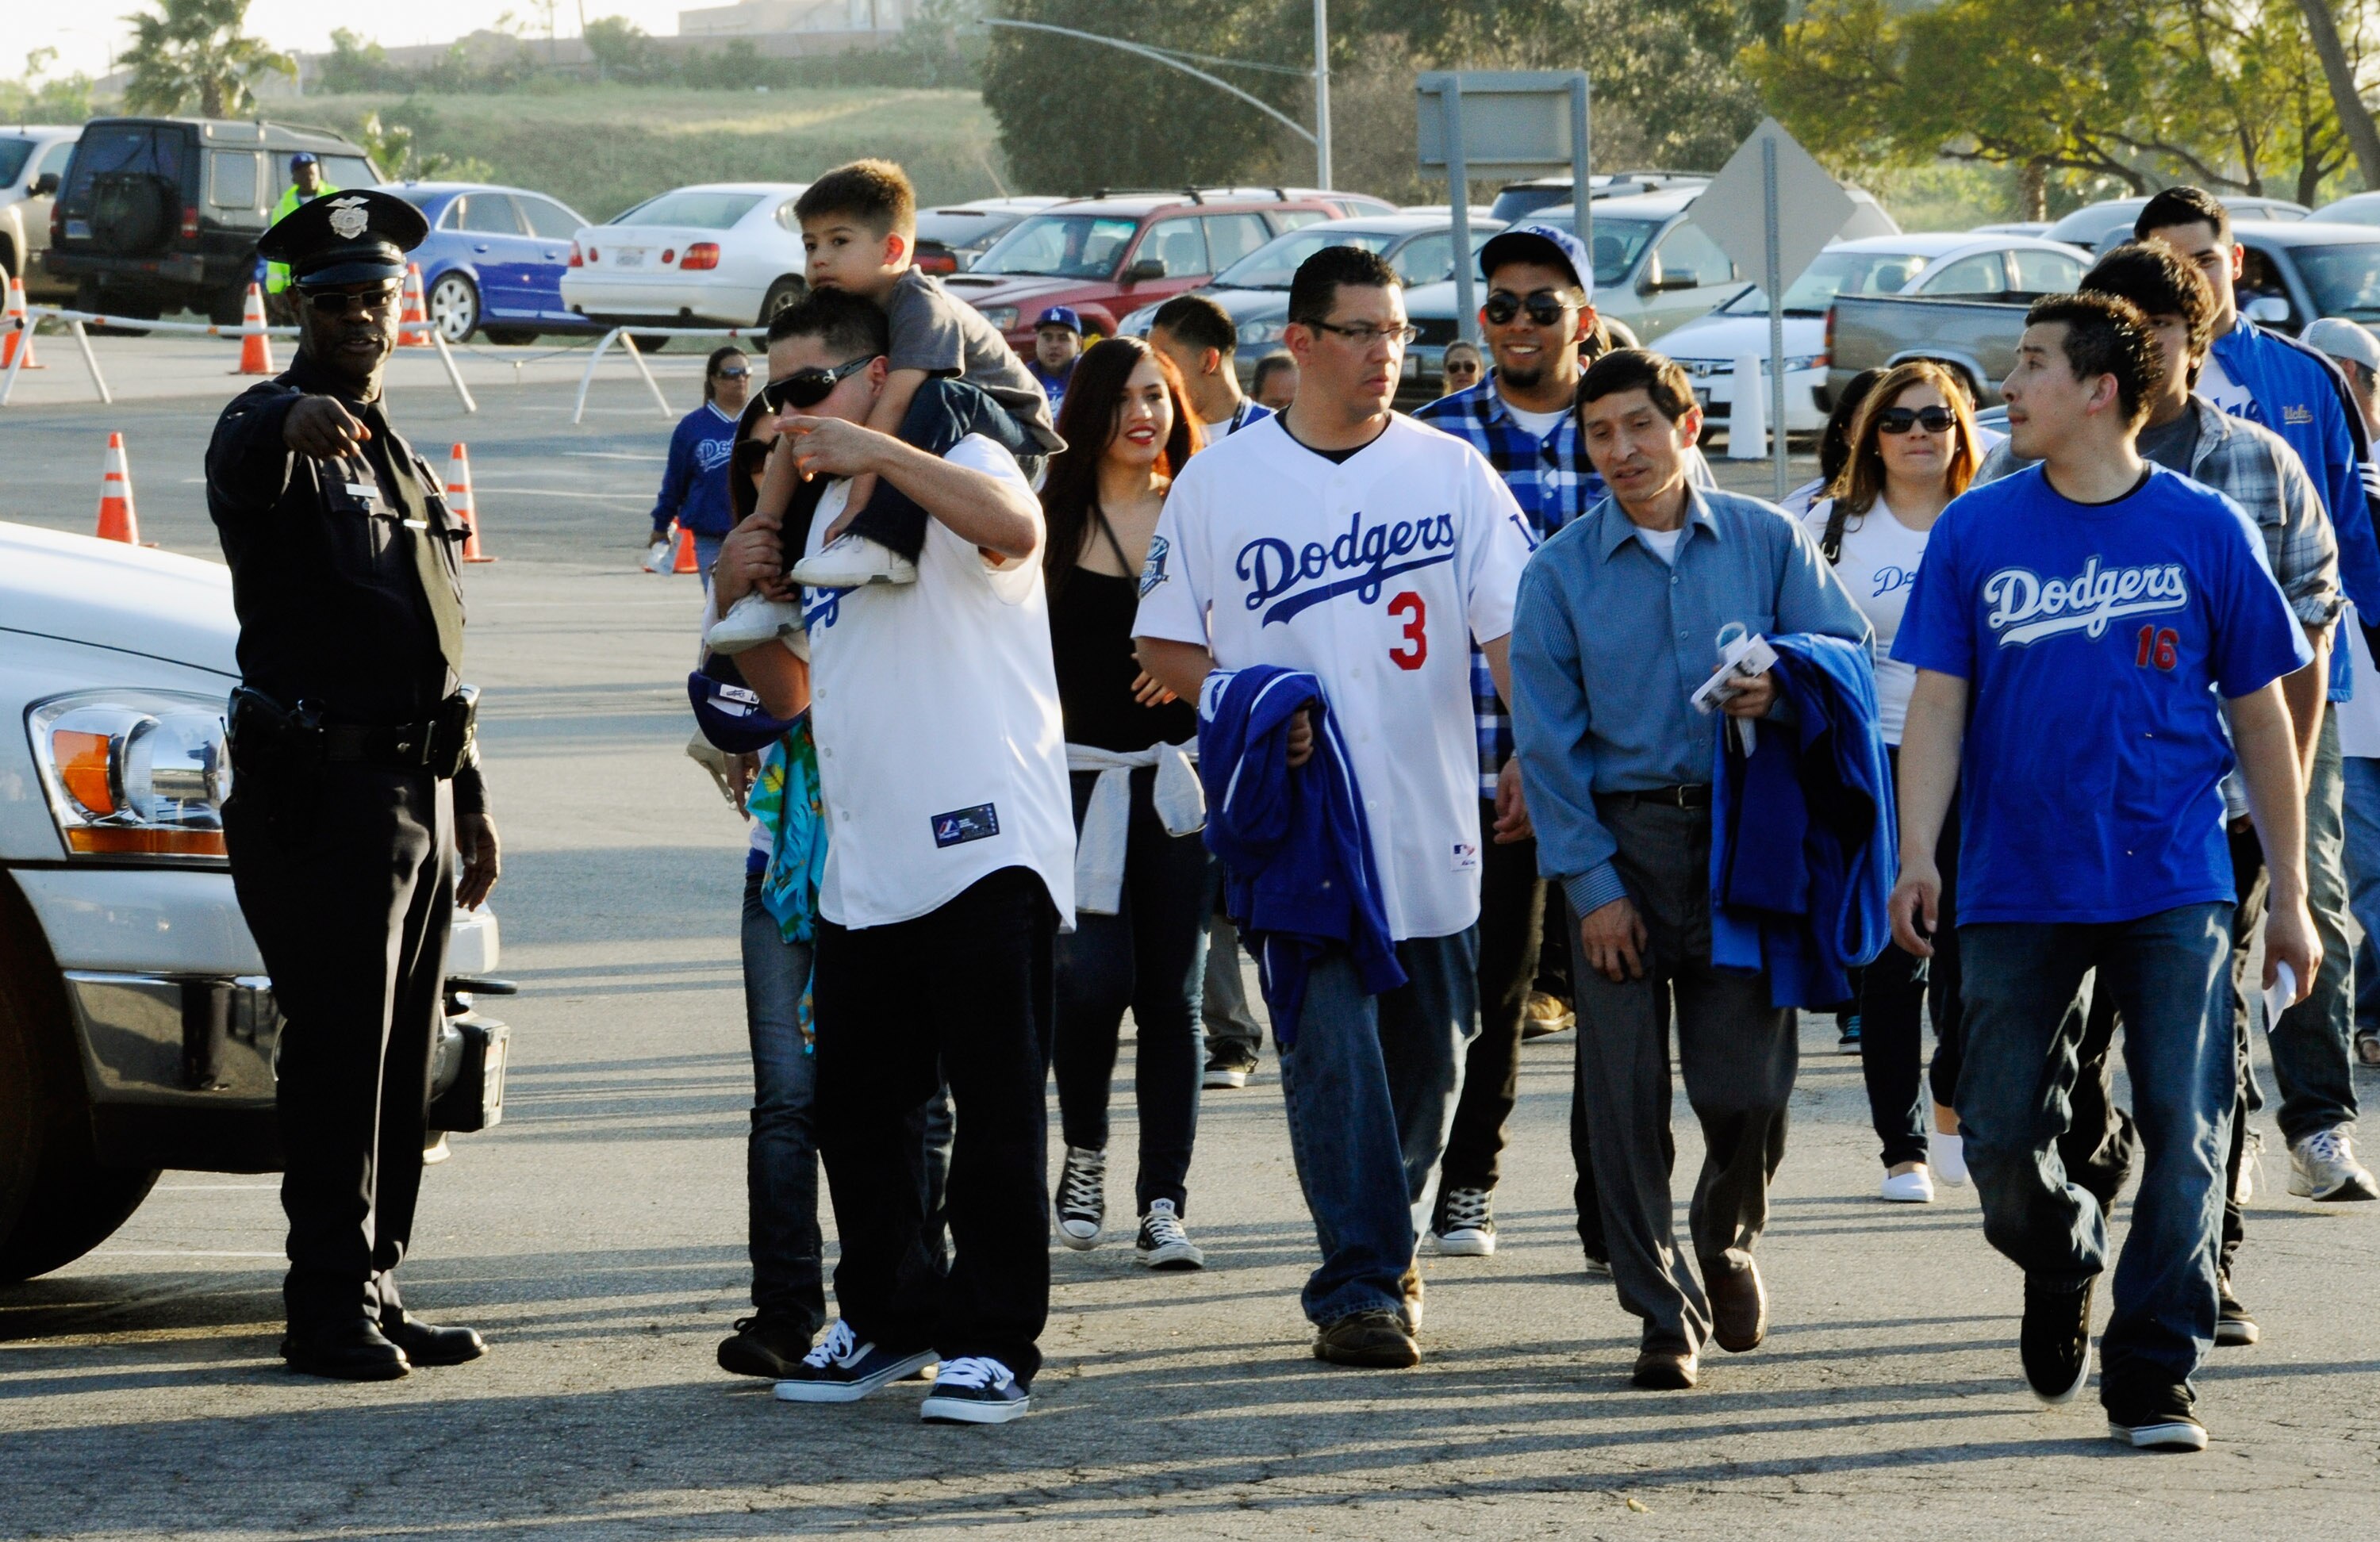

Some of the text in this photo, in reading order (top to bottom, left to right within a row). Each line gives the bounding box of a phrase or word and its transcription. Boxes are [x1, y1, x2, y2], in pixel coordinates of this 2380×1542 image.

[1236, 512, 1454, 615] Dodgers
[1872, 566, 1917, 597] Do
[1983, 555, 2188, 644] Dodgers
[1388, 591, 1427, 671] 3
[2136, 624, 2177, 671] 16
